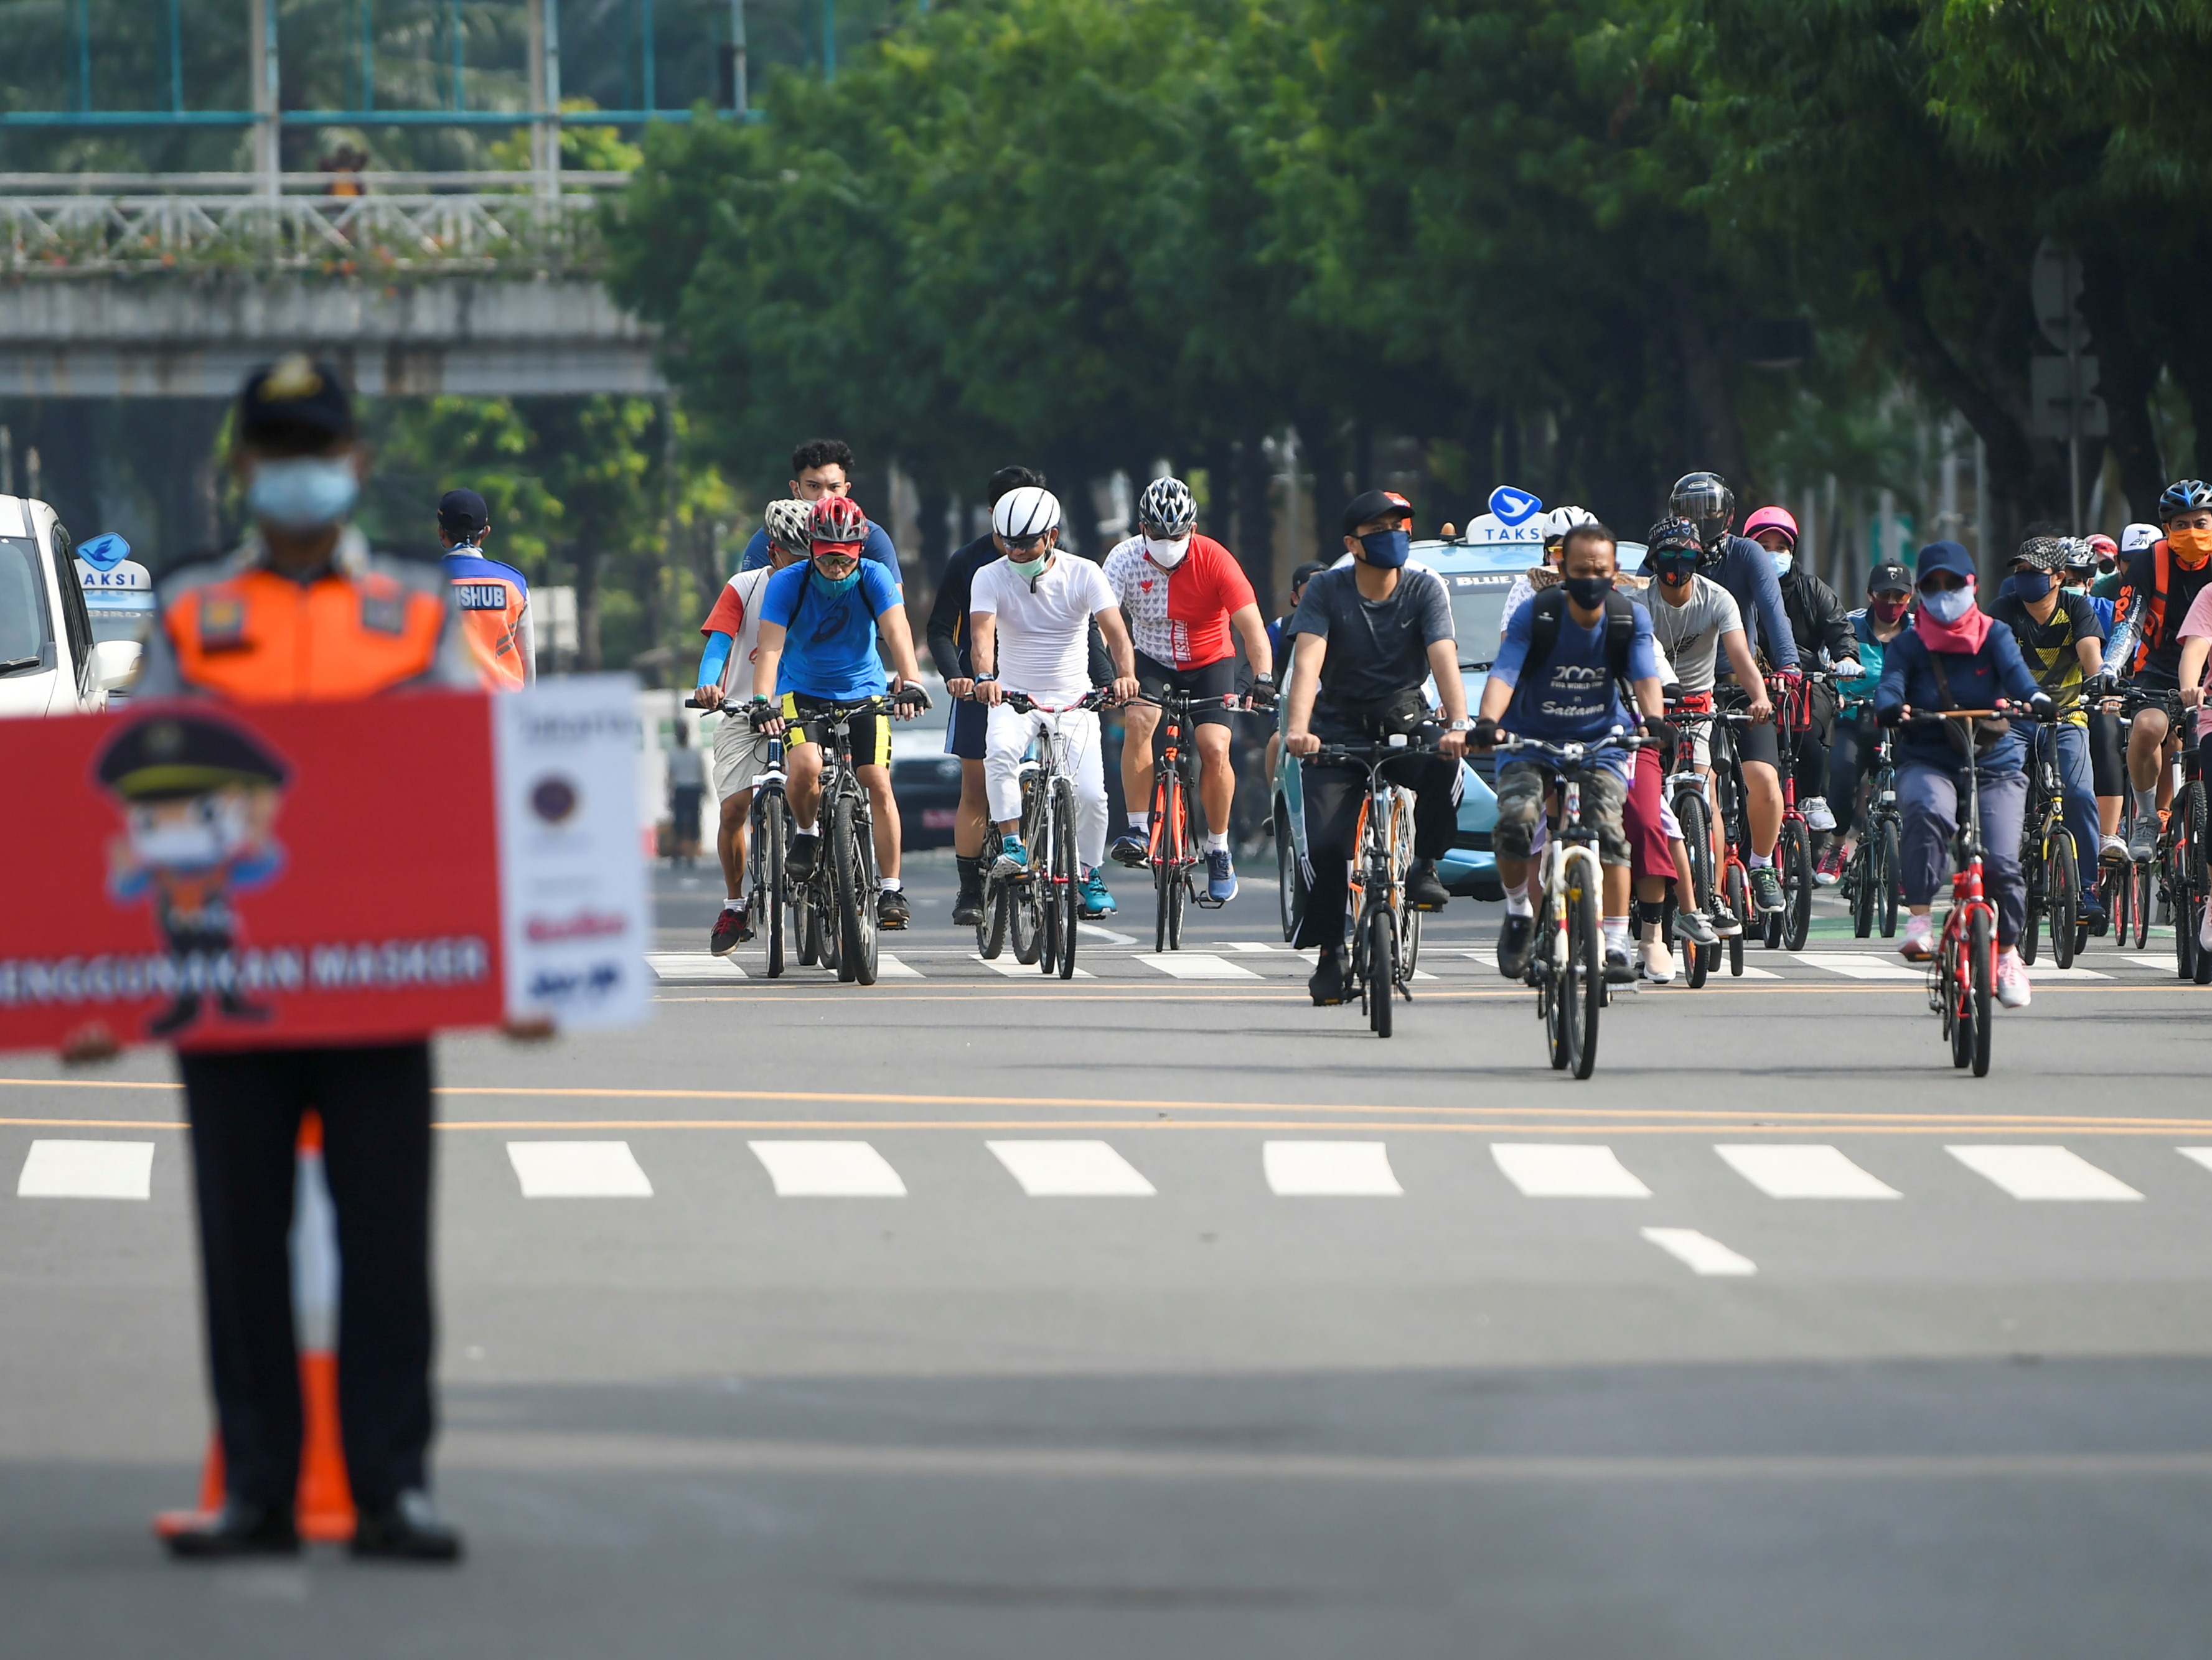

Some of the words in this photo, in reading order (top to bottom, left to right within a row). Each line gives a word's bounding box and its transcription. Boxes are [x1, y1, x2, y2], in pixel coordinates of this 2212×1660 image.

[1484, 528, 1540, 540] TAKS
[84, 573, 135, 585] AKSI
[1456, 576, 1512, 586] BLUE
[2114, 585, 2132, 622] POS
[1567, 682, 1591, 690] WORLD
[1542, 701, 1605, 716] Saitama
[313, 934, 487, 989] MASKER
